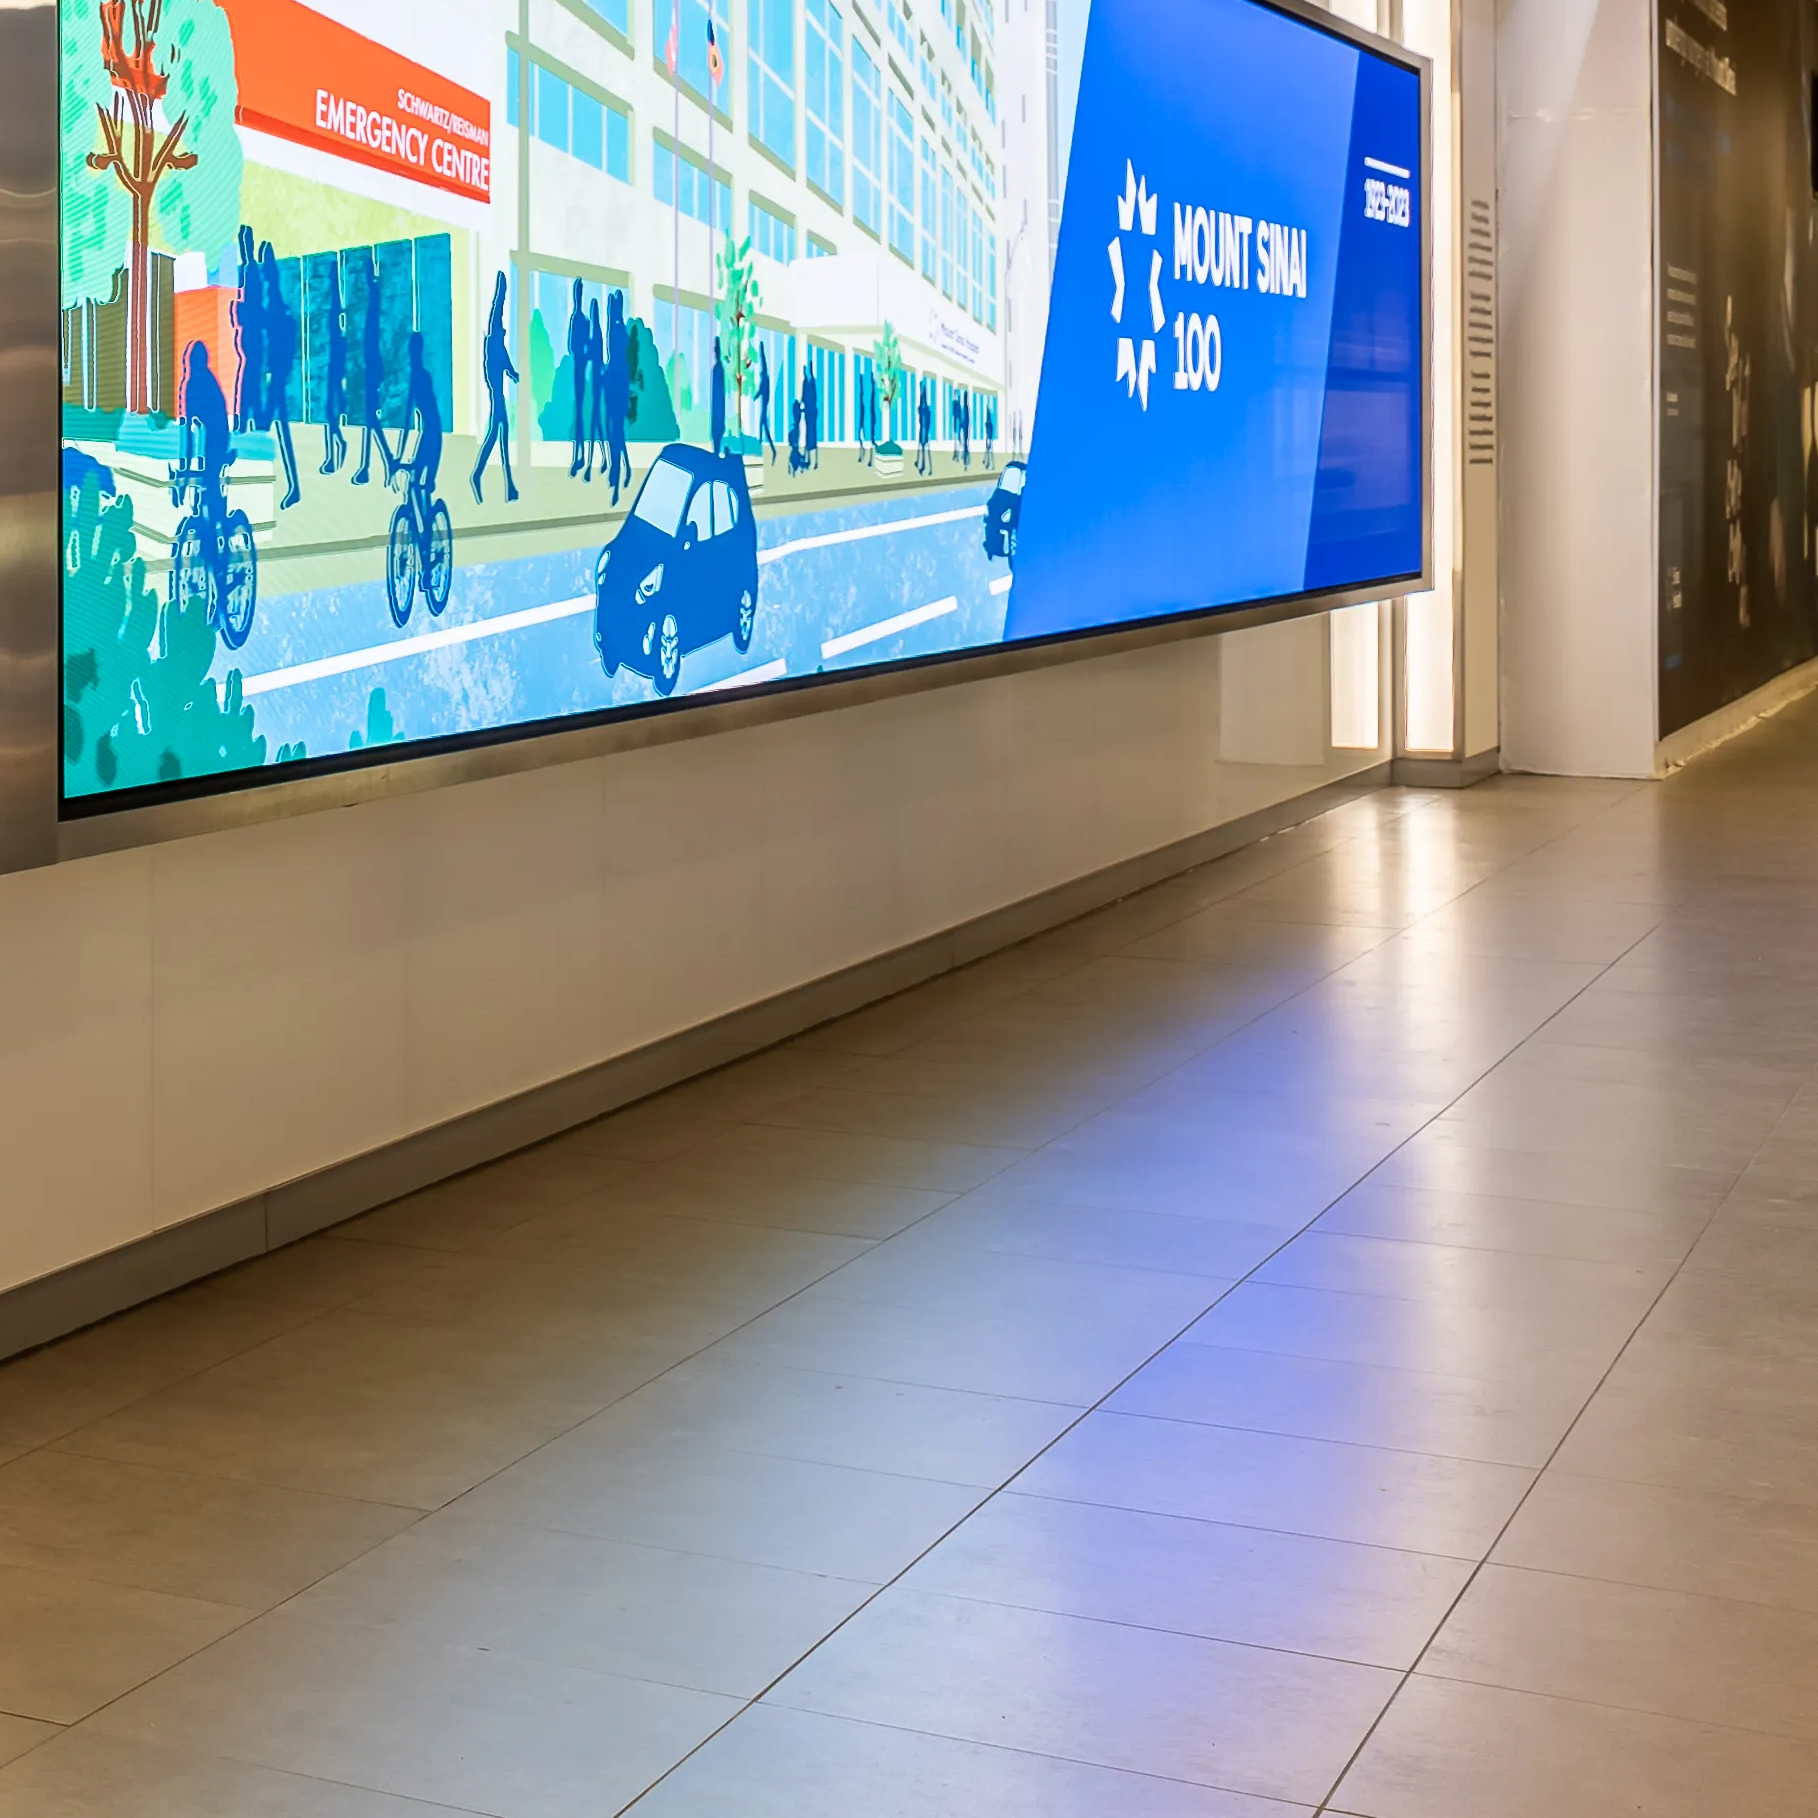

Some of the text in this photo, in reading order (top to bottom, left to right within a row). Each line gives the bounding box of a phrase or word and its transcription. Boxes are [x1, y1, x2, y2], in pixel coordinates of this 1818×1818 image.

[316, 89, 490, 191] EMERGENCY CENTRE
[1174, 201, 1307, 298] MOUNT SINAI
[1173, 312, 1222, 392] 100
